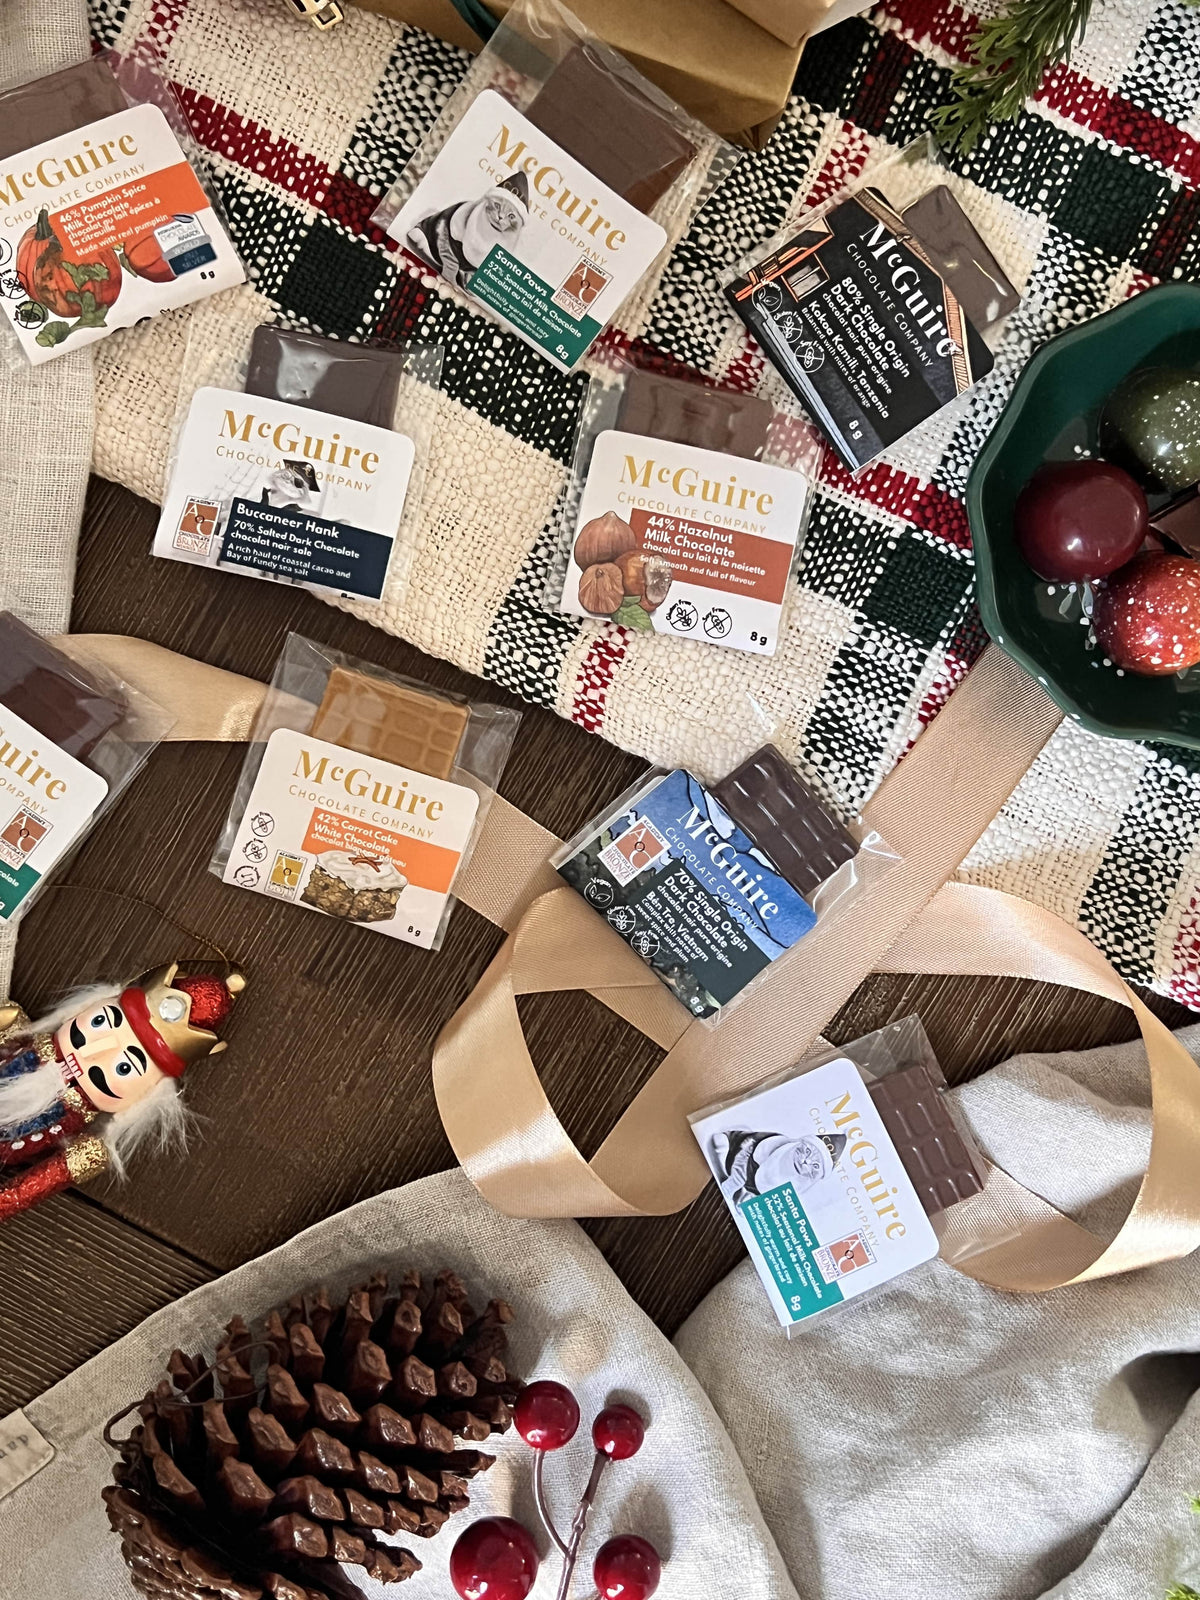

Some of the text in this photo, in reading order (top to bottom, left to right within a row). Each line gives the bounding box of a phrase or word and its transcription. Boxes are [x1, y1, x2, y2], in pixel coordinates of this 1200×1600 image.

[85, 163, 145, 193] COMPANY
[487, 125, 626, 251] McGuire
[60, 184, 146, 223] 46% Pumpkin Spice
[63, 202, 129, 233] Milk Chocolate
[113, 210, 128, 220] lait
[550, 218, 607, 266] COMPANY
[495, 250, 547, 297] Santa Paws
[860, 222, 960, 358] McGuire
[521, 297, 533, 310] lait
[532, 308, 542, 317] de
[533, 298, 548, 312] Milk
[549, 310, 582, 338] Chocolate
[847, 243, 933, 366] CHOCOLATE COMPANY
[822, 293, 892, 394] chocolat noir pure origine
[830, 283, 895, 371] Dark Chocolate
[841, 276, 910, 378] 80% Single Origin
[555, 344, 569, 360] 8g
[808, 300, 889, 418] Kokoa Kamili, Tanzania
[823, 339, 836, 356] with
[834, 356, 849, 376] notes
[847, 376, 856, 384] of
[218, 410, 379, 474] McGuire
[849, 420, 863, 440] 8 g
[619, 455, 773, 515] McGuire
[237, 503, 339, 538] Buccaneer Hank
[617, 491, 766, 533] CHOCOLATE COMPANY
[647, 515, 733, 544] 44% Hazelnut
[230, 530, 291, 551] chocolat noir
[234, 519, 360, 559] 70% Salted Dark Chocolate
[642, 541, 766, 576] chocolat au lait à la noisette
[644, 528, 735, 558] Milk Chocolate
[226, 550, 242, 561] Bay
[279, 564, 292, 572] sea
[294, 568, 308, 576] salt
[235, 545, 251, 553] rich
[252, 548, 271, 559] haul
[281, 557, 311, 569] coastal
[335, 570, 351, 579] and
[689, 567, 705, 575] and
[706, 569, 719, 578] full
[750, 631, 768, 646] 8 g
[292, 750, 443, 821] McGuire
[289, 784, 366, 818] CHOCOLATE
[371, 811, 434, 838] COMPANY
[317, 813, 398, 845] 42% Carrot Cake
[311, 832, 344, 848] chocolat
[314, 822, 390, 854] White Chocolate
[604, 849, 632, 880] BRONZE
[665, 827, 758, 930] CHOCOLATE COMPANY
[676, 805, 779, 920] McGuire
[407, 925, 414, 933] 8
[657, 885, 732, 968] chocolat noir pure origine
[664, 876, 728, 948] Dark Chocolate
[674, 868, 748, 952] 70% Single Origin
[664, 936, 677, 948] and
[673, 947, 689, 963] plum
[677, 923, 709, 962] Vietnam
[688, 996, 704, 1015] 8 g
[824, 1090, 906, 1240] McGuire
[771, 1193, 784, 1211] 52%
[782, 1188, 813, 1247] Santa Paws
[846, 1186, 880, 1246] COMPANY
[764, 1197, 782, 1228] chocolat
[783, 1238, 793, 1252] lait
[789, 1252, 797, 1262] de
[777, 1211, 800, 1245] Seasonal
[795, 1244, 807, 1262] Milk
[803, 1261, 822, 1299] Chocolate
[790, 1295, 801, 1311] 8g
